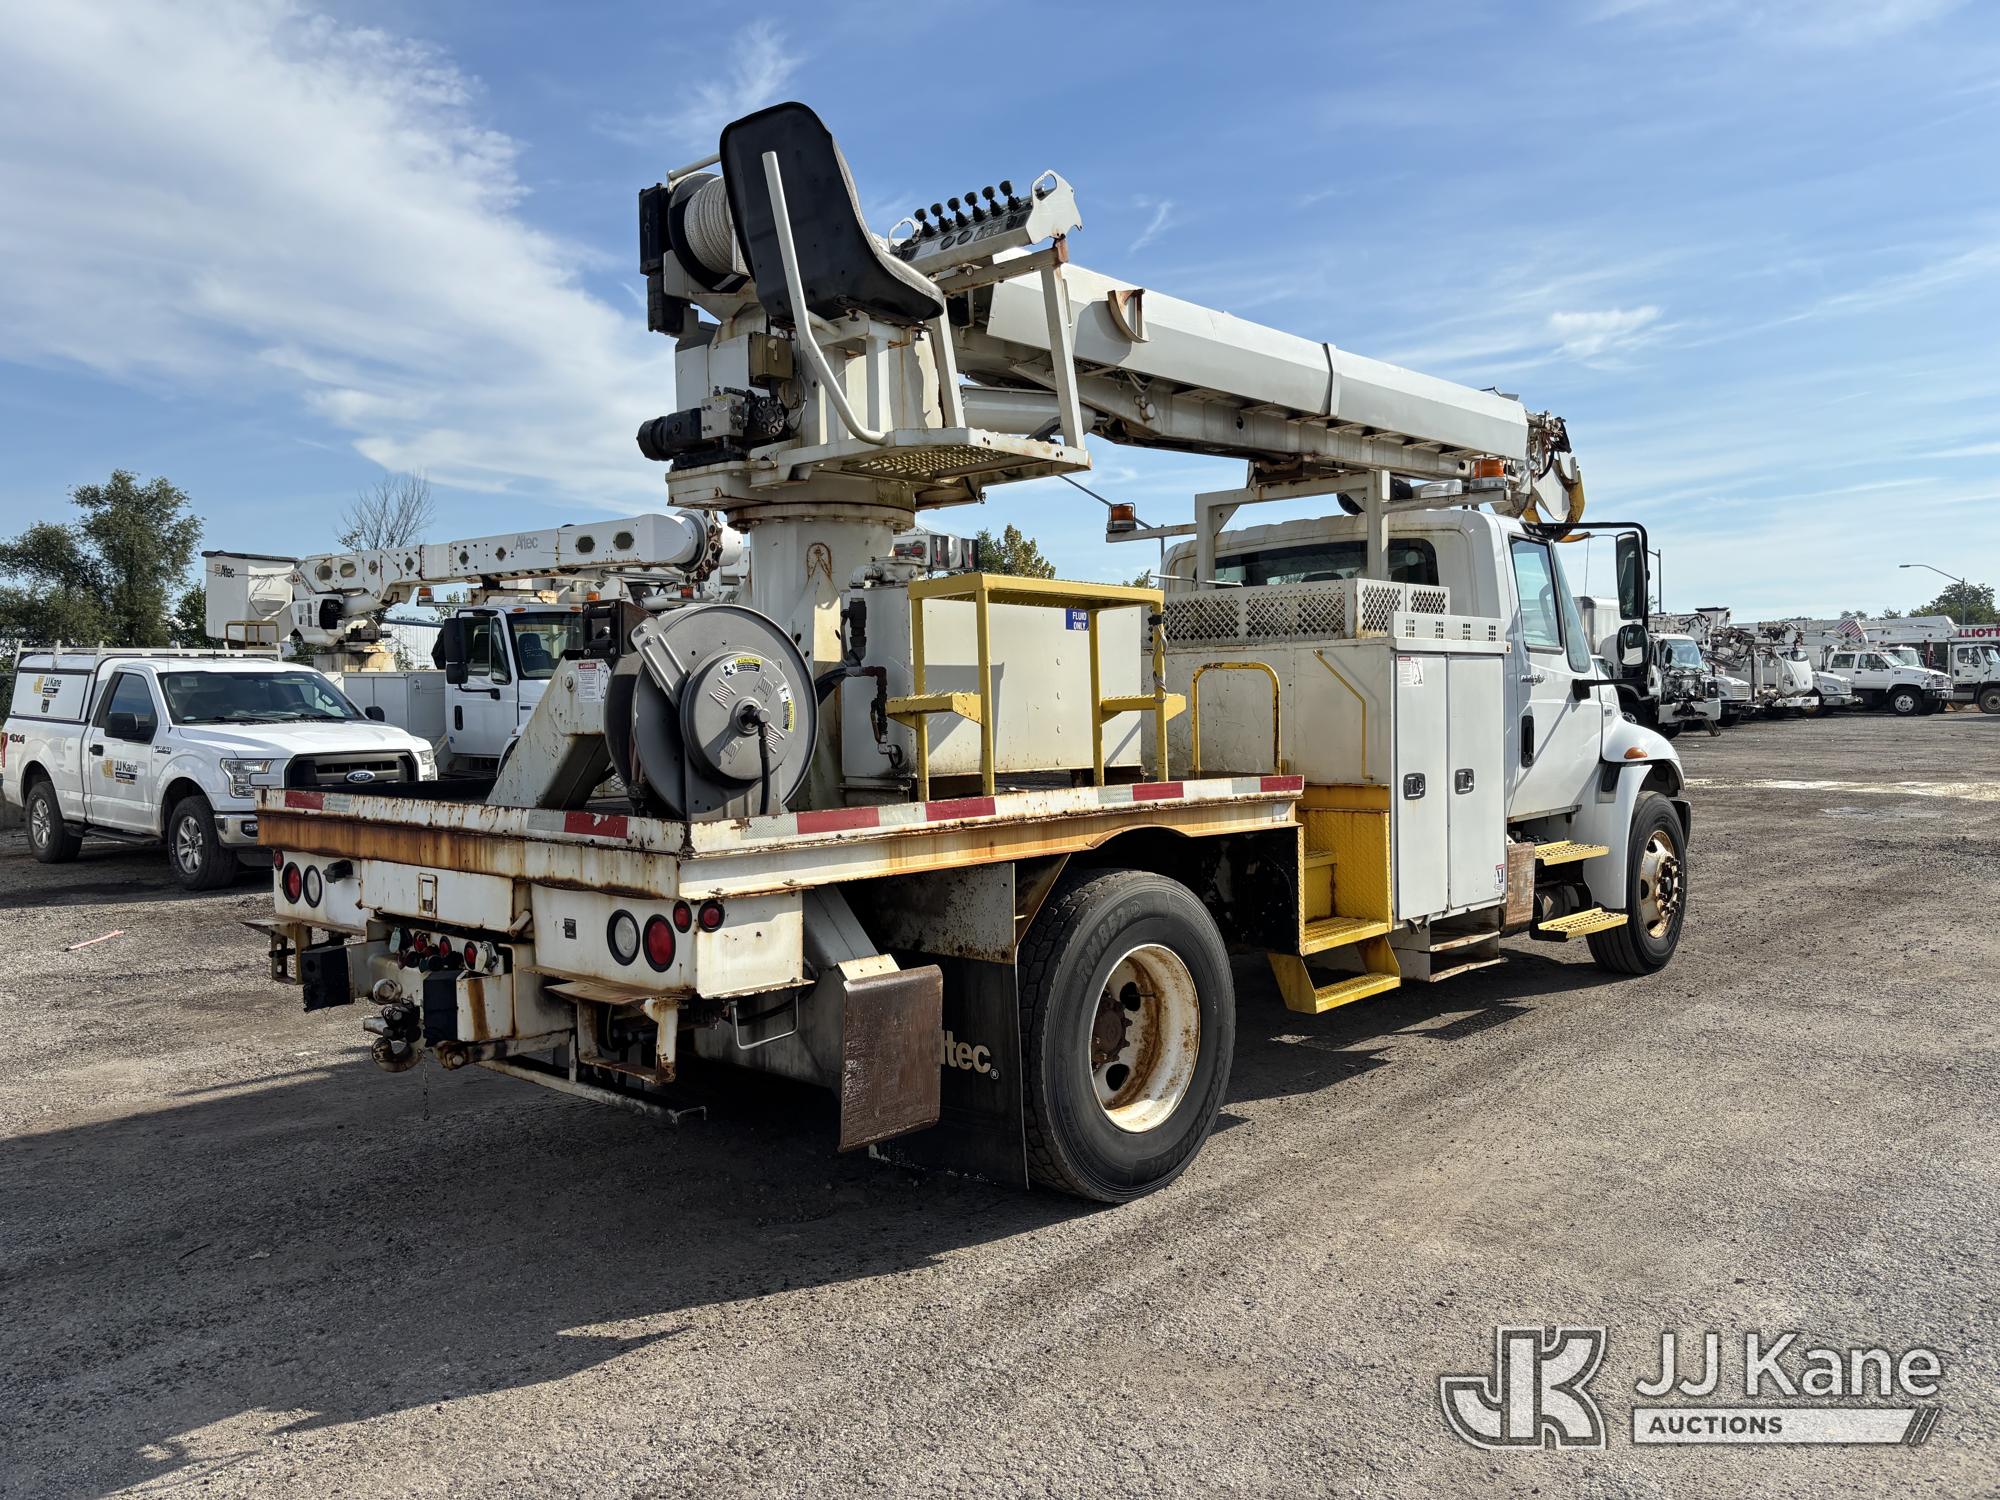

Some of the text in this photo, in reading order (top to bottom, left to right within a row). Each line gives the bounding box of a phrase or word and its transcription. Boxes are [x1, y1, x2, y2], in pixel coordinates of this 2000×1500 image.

[1072, 611, 1087, 620] FLUID
[1073, 621, 1086, 630] ONLY
[1958, 628, 2000, 638] LLIOTT
[115, 760, 138, 773] JJ Kane
